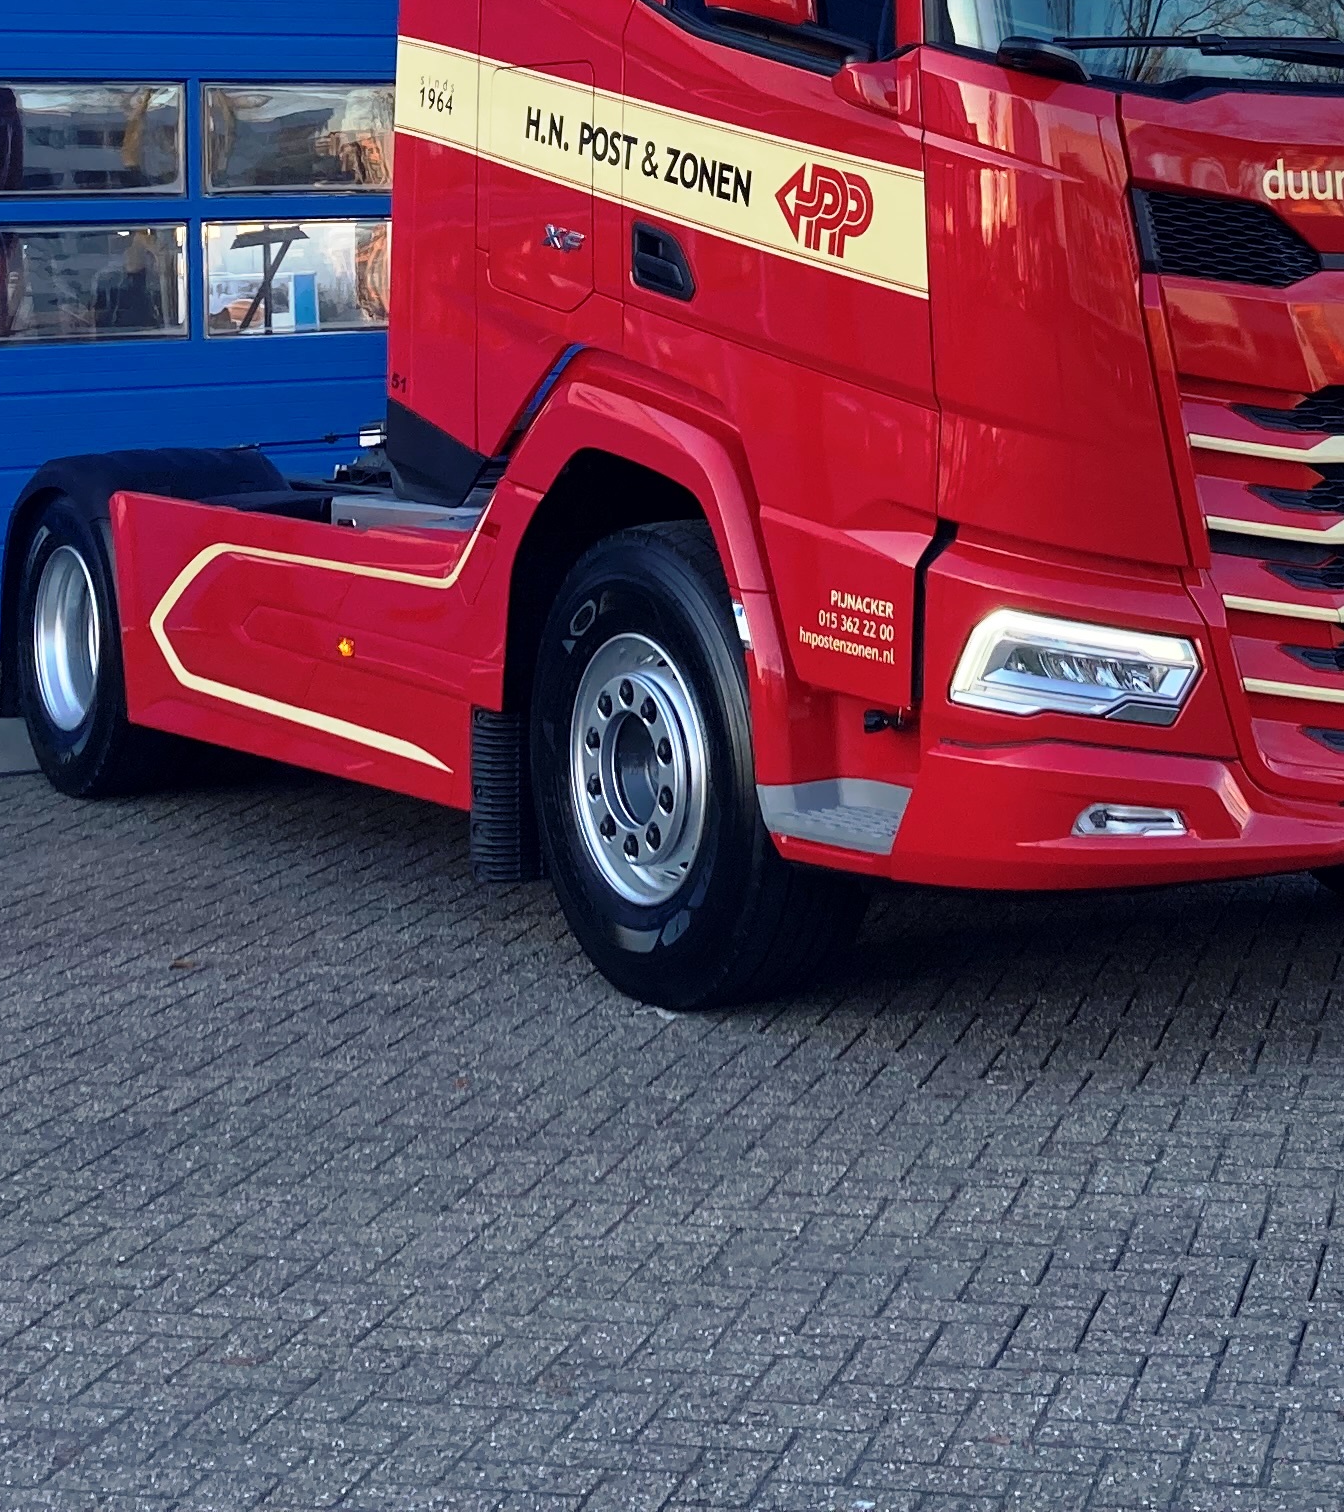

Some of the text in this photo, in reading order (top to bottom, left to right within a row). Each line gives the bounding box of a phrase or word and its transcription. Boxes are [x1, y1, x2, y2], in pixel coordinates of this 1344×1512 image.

[420, 86, 453, 116] 1964
[525, 107, 569, 152] H.N.
[578, 121, 638, 171] POST
[641, 140, 659, 180] &
[664, 146, 753, 208] ZONEN
[391, 372, 407, 393] 51
[830, 589, 895, 619] PIJNACKER
[818, 610, 895, 643] 015 362 22 00
[799, 625, 895, 665] hnpostenzonen.nl
